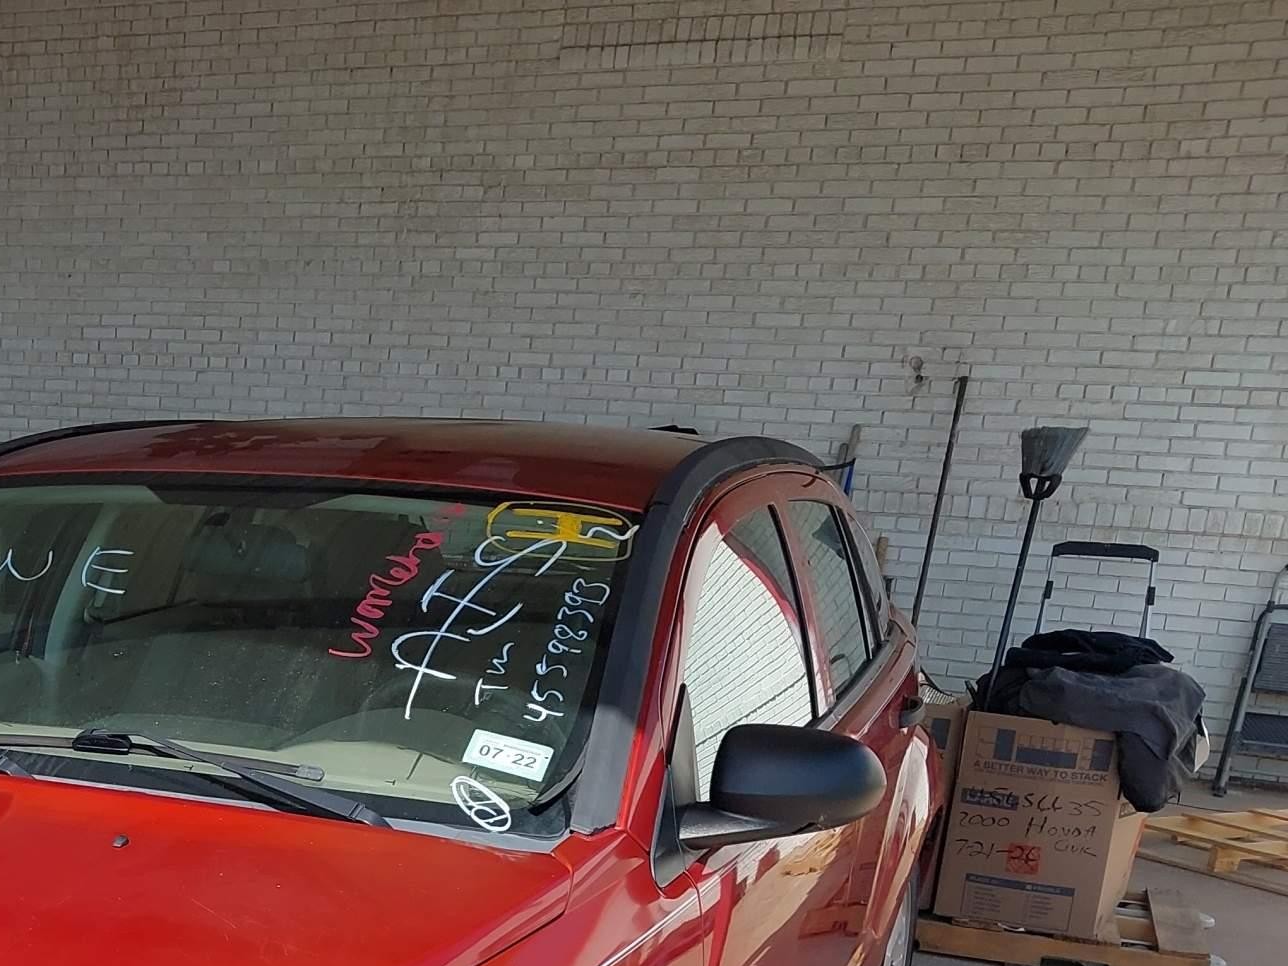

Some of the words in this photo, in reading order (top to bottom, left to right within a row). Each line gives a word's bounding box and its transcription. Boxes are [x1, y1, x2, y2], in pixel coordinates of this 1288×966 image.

[523, 577, 611, 723] 45598393
[479, 742, 504, 761] 07
[511, 751, 538, 769] 22
[973, 759, 981, 769] A
[983, 760, 1024, 775] BETTER
[1027, 767, 1050, 778] WAY
[1053, 770, 1068, 780] TO
[1070, 771, 1109, 782] STACK
[959, 811, 1010, 827] 2000
